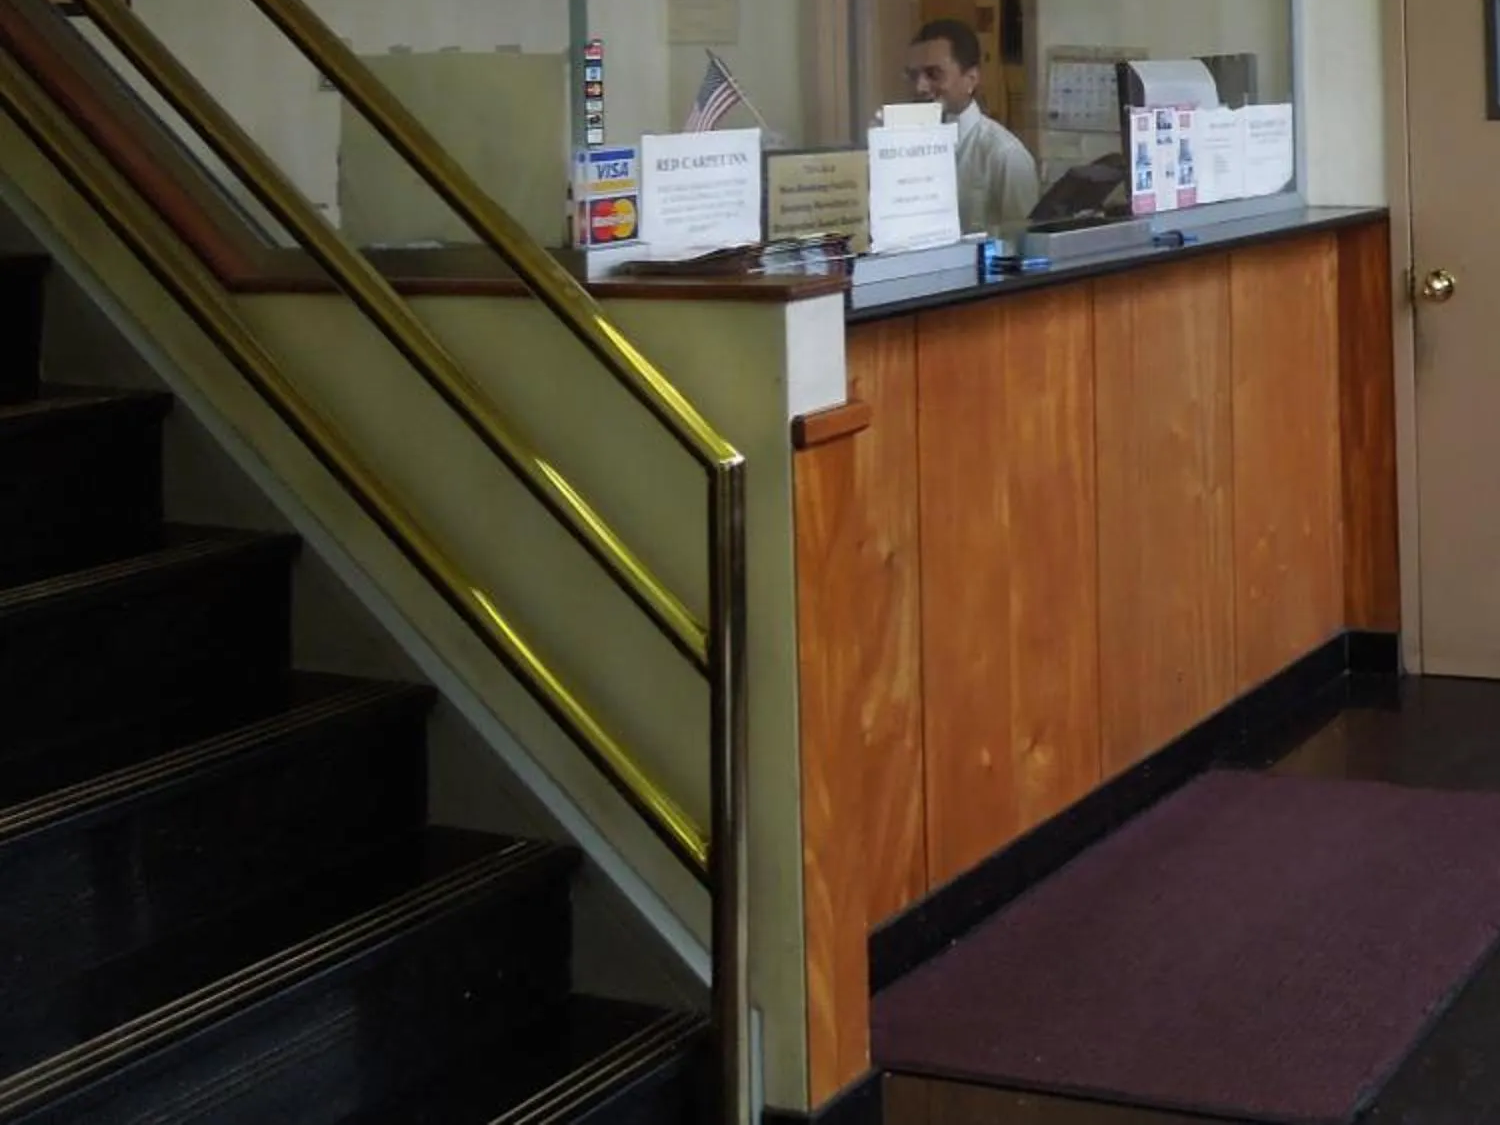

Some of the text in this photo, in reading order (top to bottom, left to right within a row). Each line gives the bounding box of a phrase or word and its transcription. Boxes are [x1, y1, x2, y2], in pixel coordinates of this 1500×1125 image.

[879, 148, 896, 160] RED
[596, 161, 629, 179] VISA
[656, 158, 680, 172] RED
